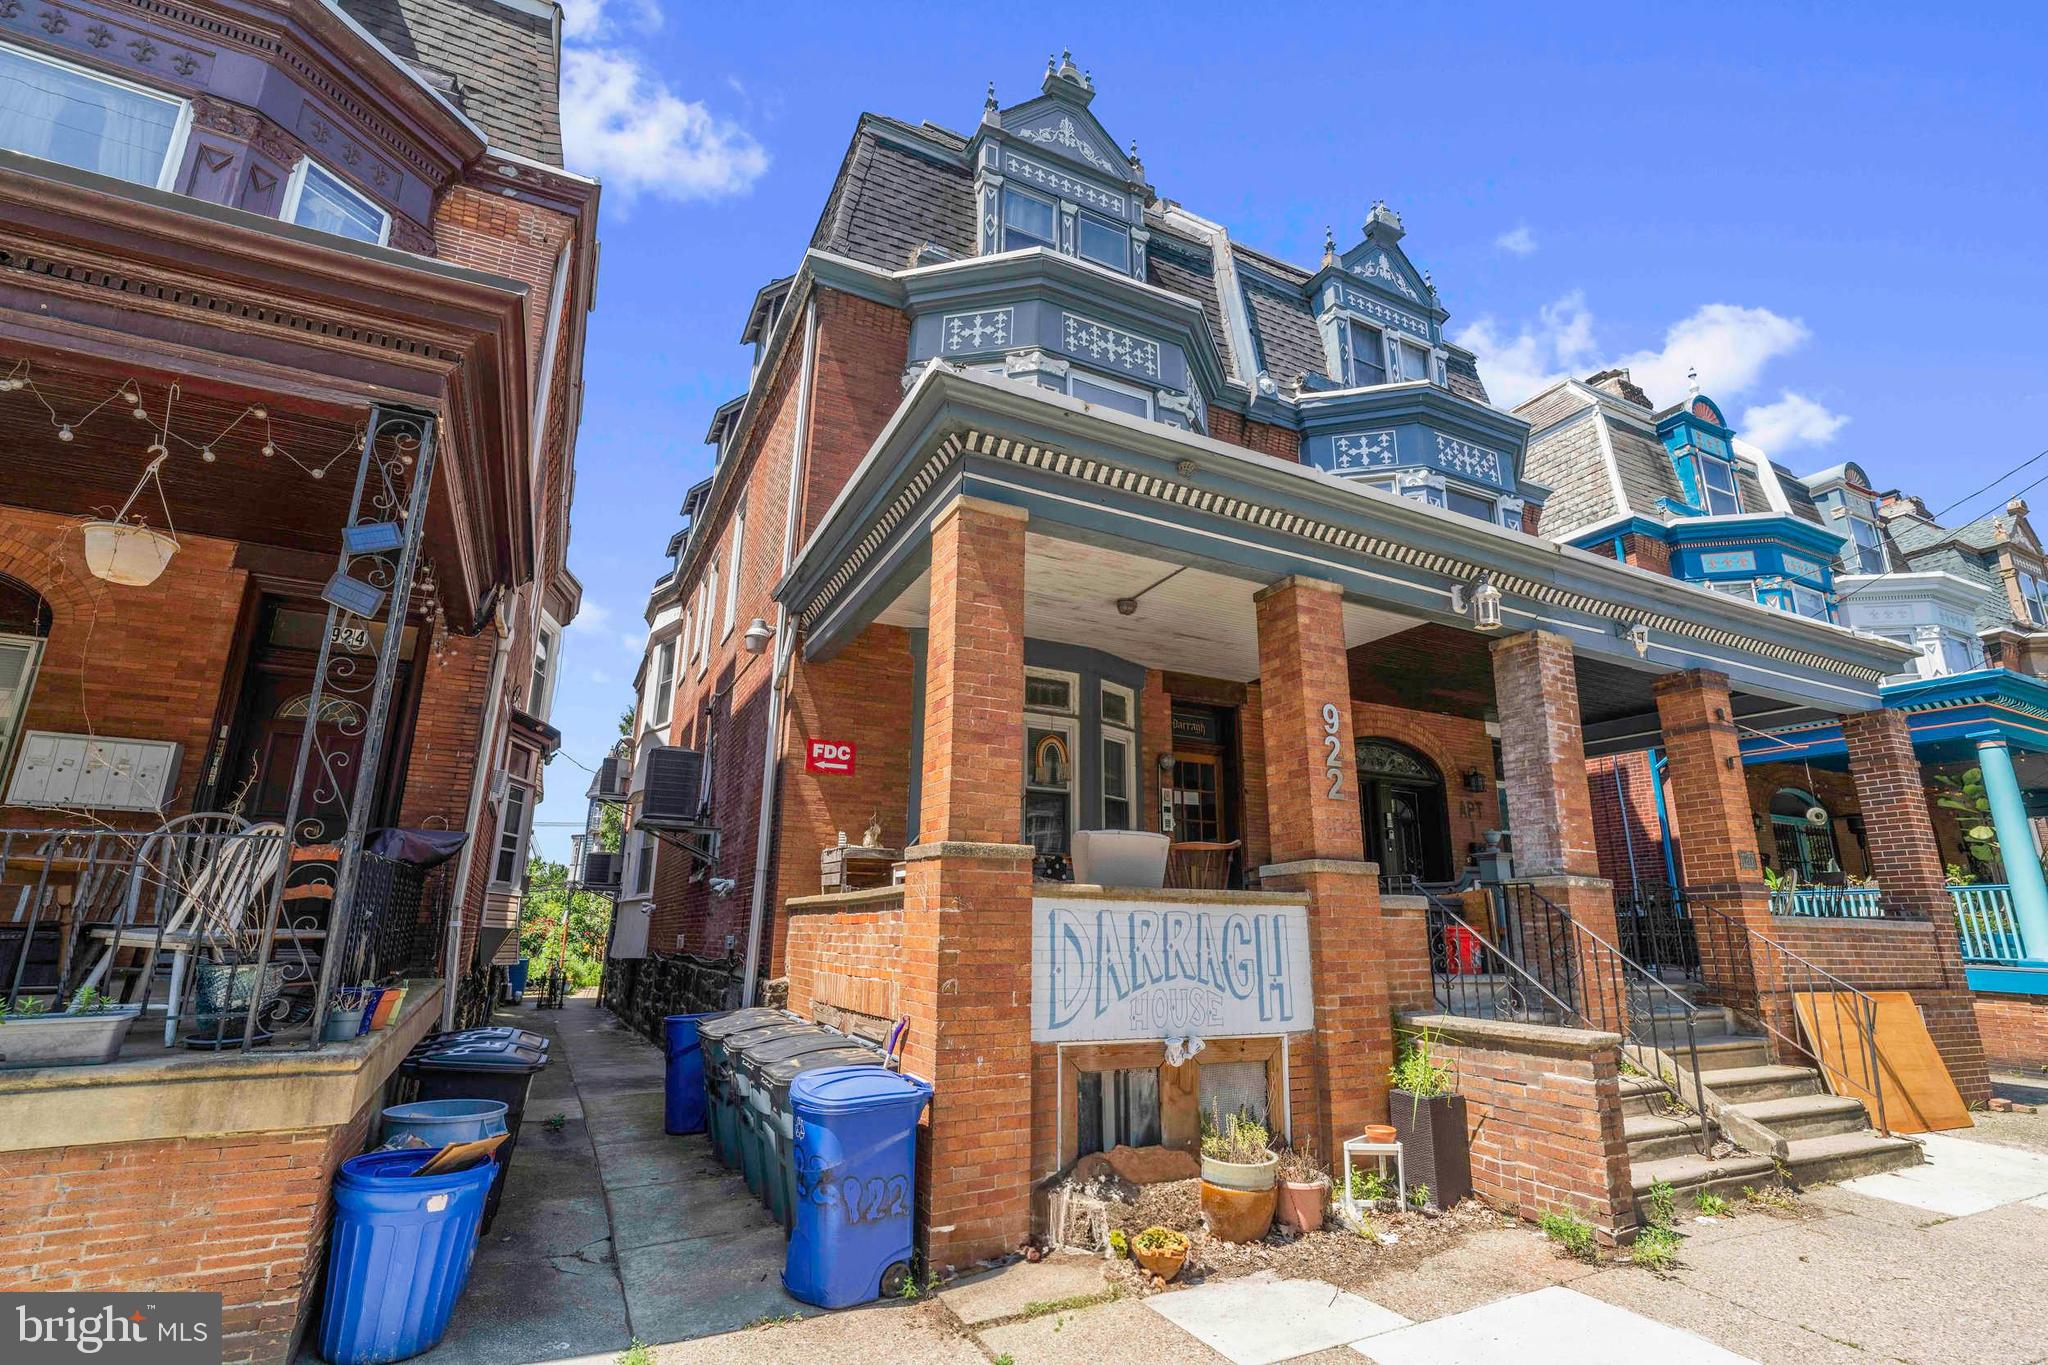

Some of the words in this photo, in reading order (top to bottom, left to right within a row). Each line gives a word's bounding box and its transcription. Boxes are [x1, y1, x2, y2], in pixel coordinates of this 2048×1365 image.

[331, 627, 366, 646] 924
[812, 743, 851, 760] FDC
[1322, 703, 1345, 800] 922
[1048, 908, 1294, 1030] DARRAGH
[1129, 987, 1225, 1031] HOUSE
[841, 1174, 910, 1225] 922
